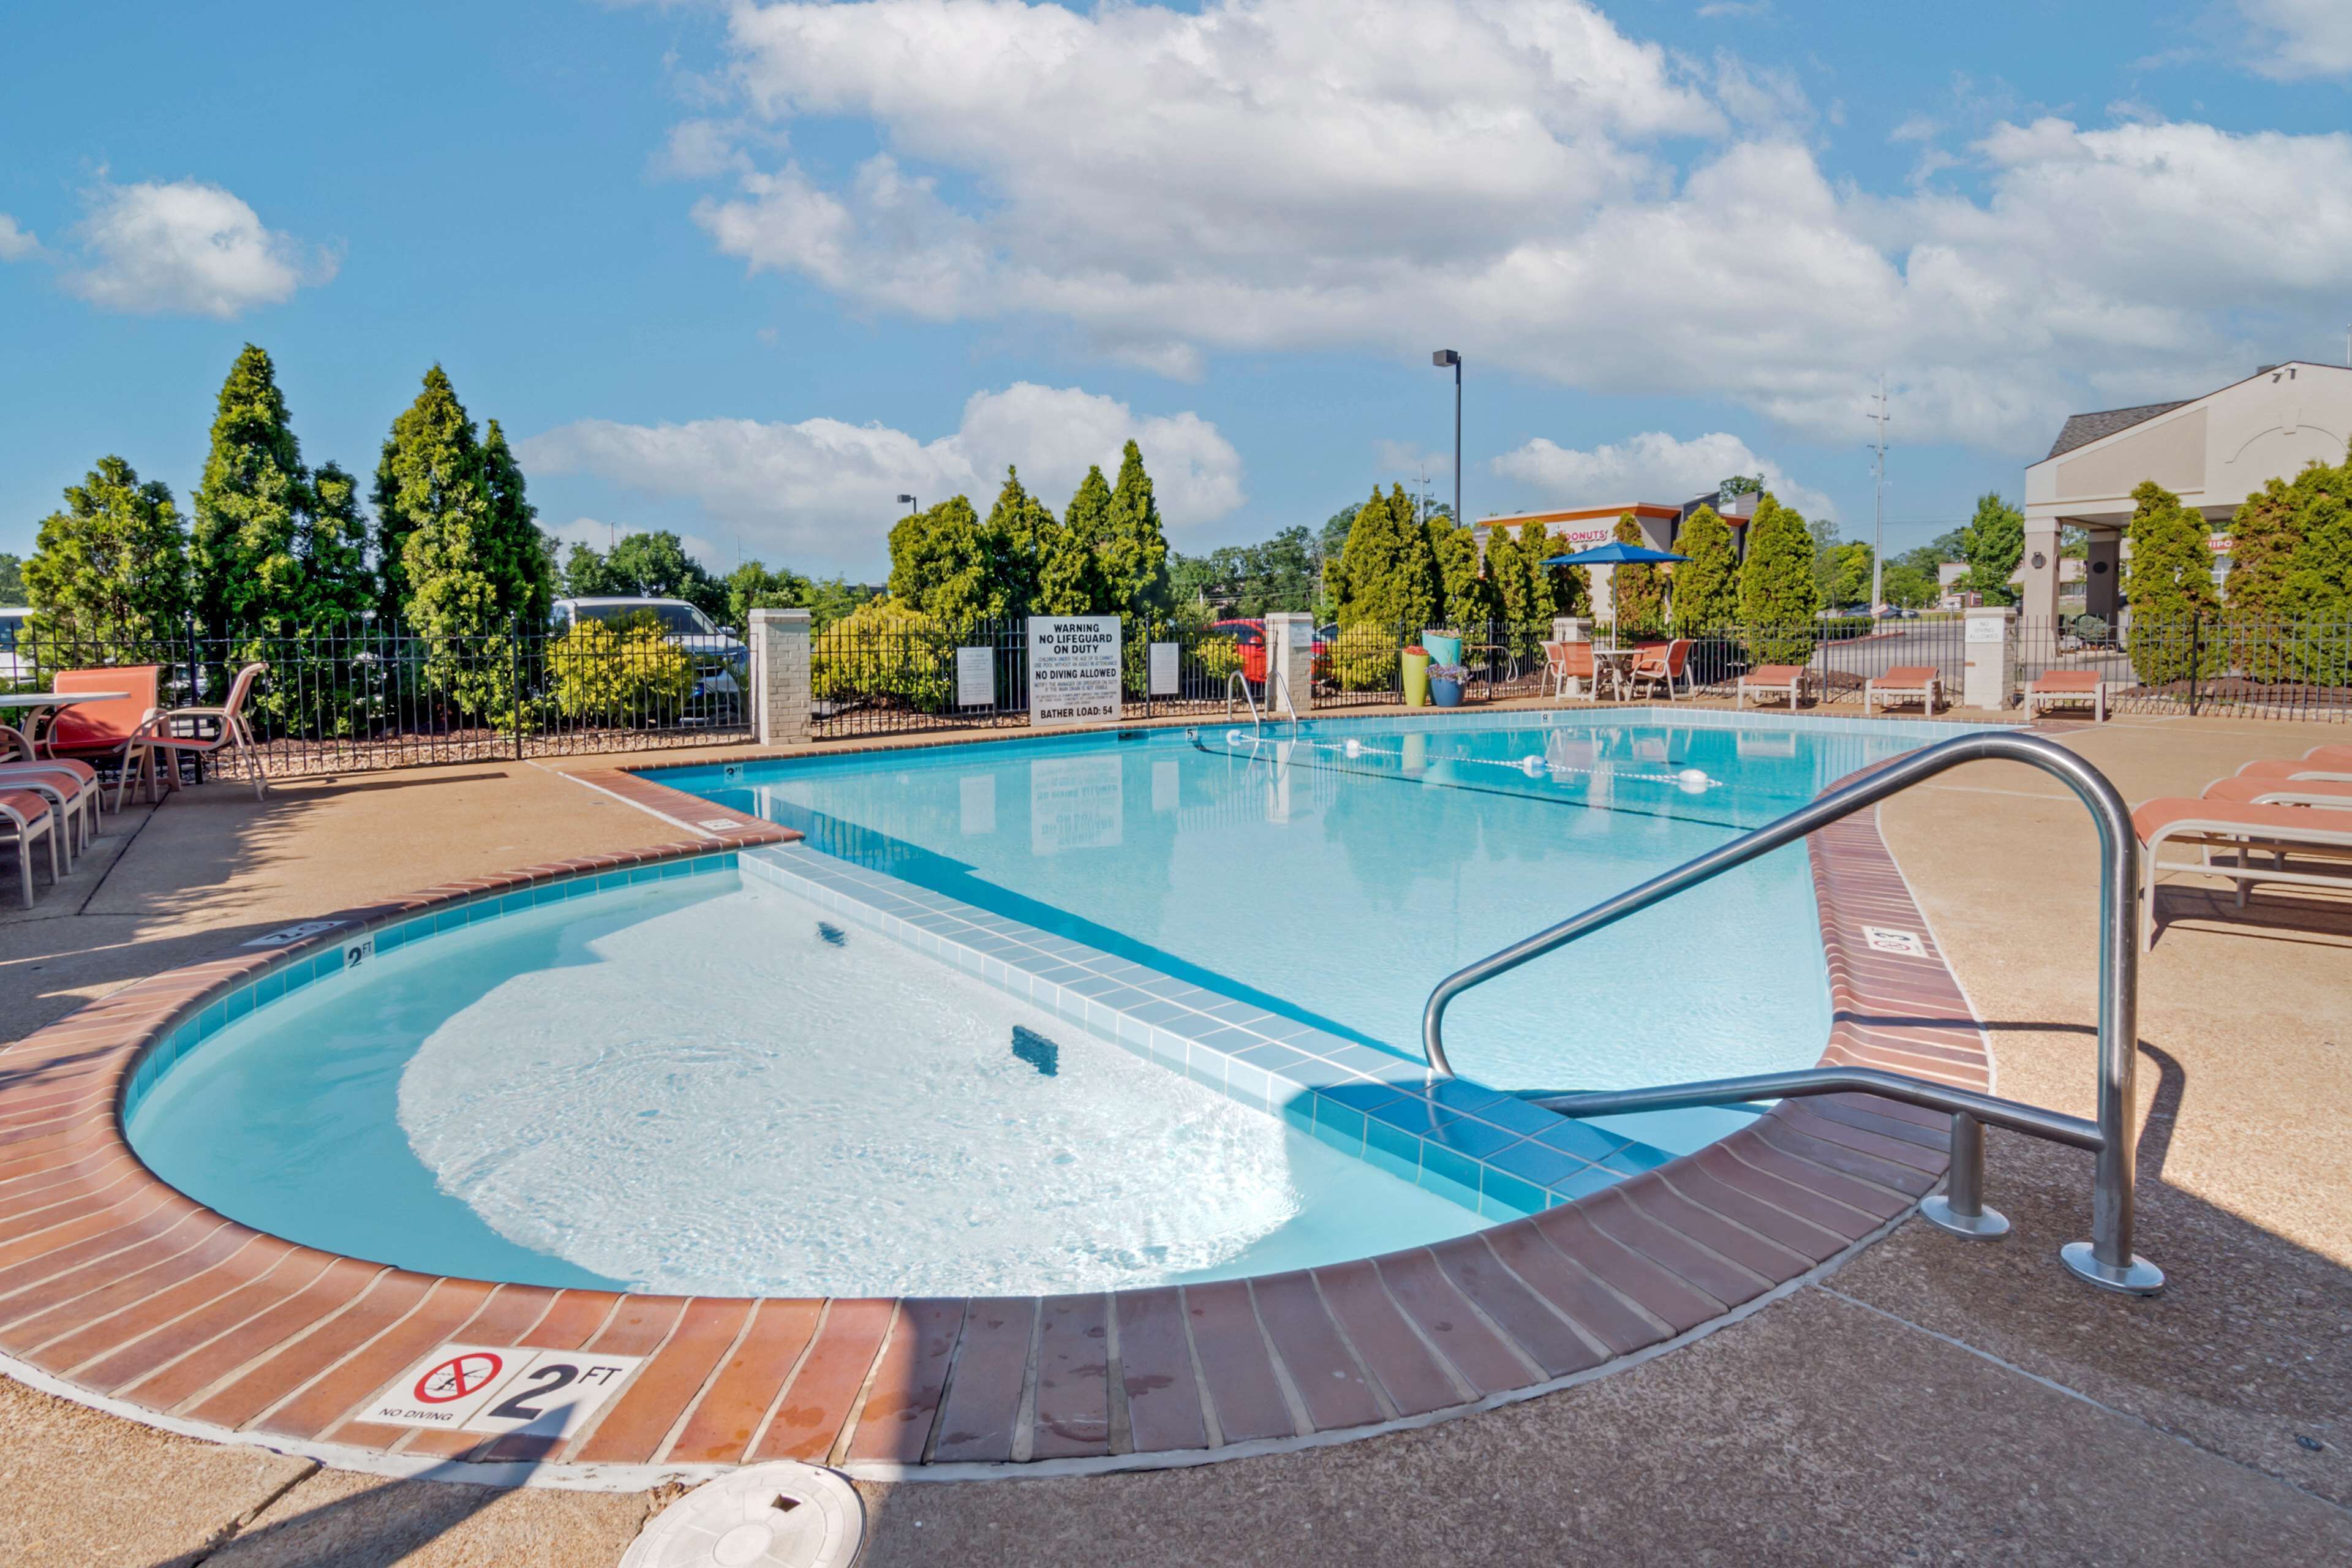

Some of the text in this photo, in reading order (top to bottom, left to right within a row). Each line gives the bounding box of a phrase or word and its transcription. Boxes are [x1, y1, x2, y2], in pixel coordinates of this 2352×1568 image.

[1054, 624, 1099, 633] WARNING
[1039, 634, 1112, 644] NO LIFEGUARD
[1054, 644, 1099, 654] ON DUTY
[1036, 668, 1117, 680] NO DIVING ALLOWED
[1041, 706, 1112, 719] BATHER LOAD: 54
[348, 941, 372, 968] 2 FT
[488, 1363, 624, 1420] 2 FT
[379, 1408, 454, 1422] NO DIVING
